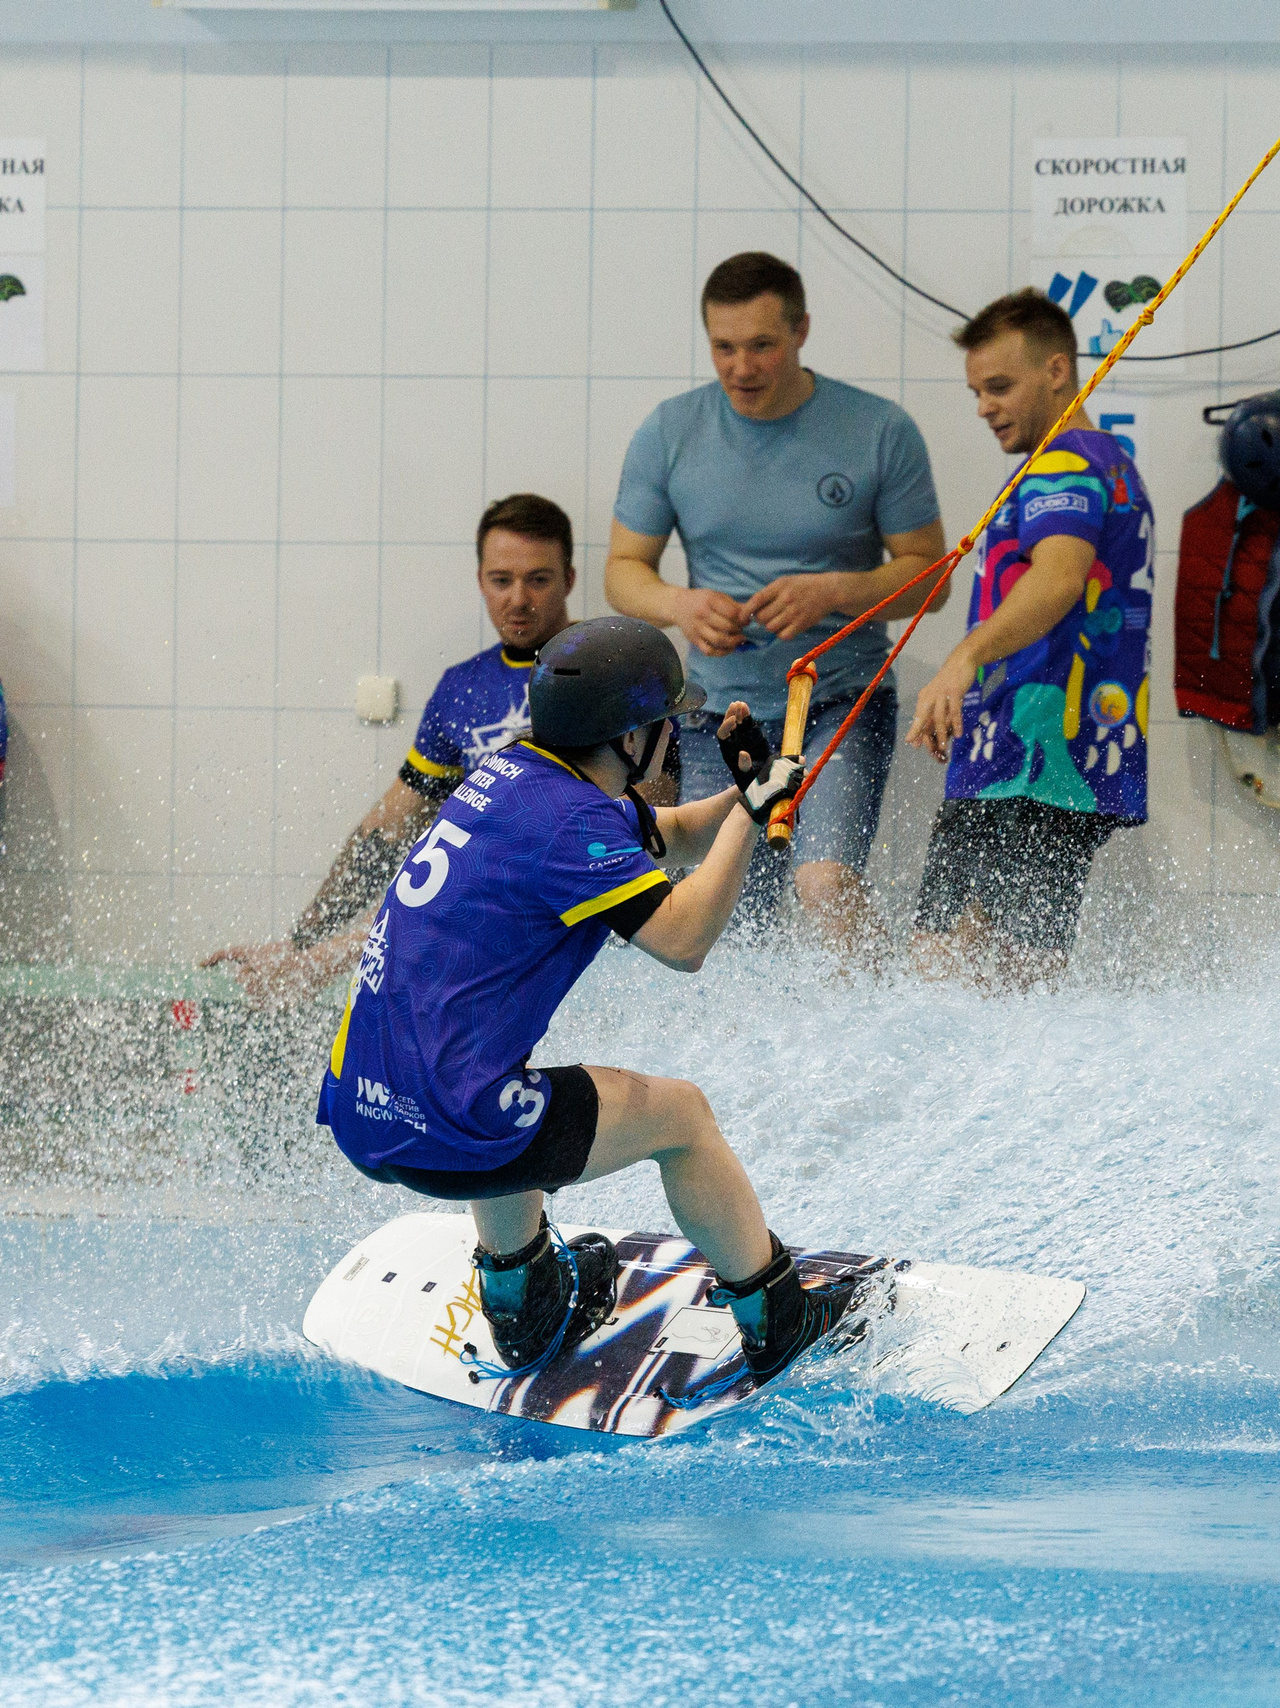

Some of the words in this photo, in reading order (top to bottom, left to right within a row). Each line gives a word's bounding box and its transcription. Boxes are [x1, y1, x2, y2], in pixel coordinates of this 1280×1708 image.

[1, 158, 45, 175] НАЯ
[1034, 157, 1187, 176] СКОРОСТНАЯ
[1053, 197, 1167, 217] ДОРОЖКА
[397, 1095, 416, 1105] СЕТЬ
